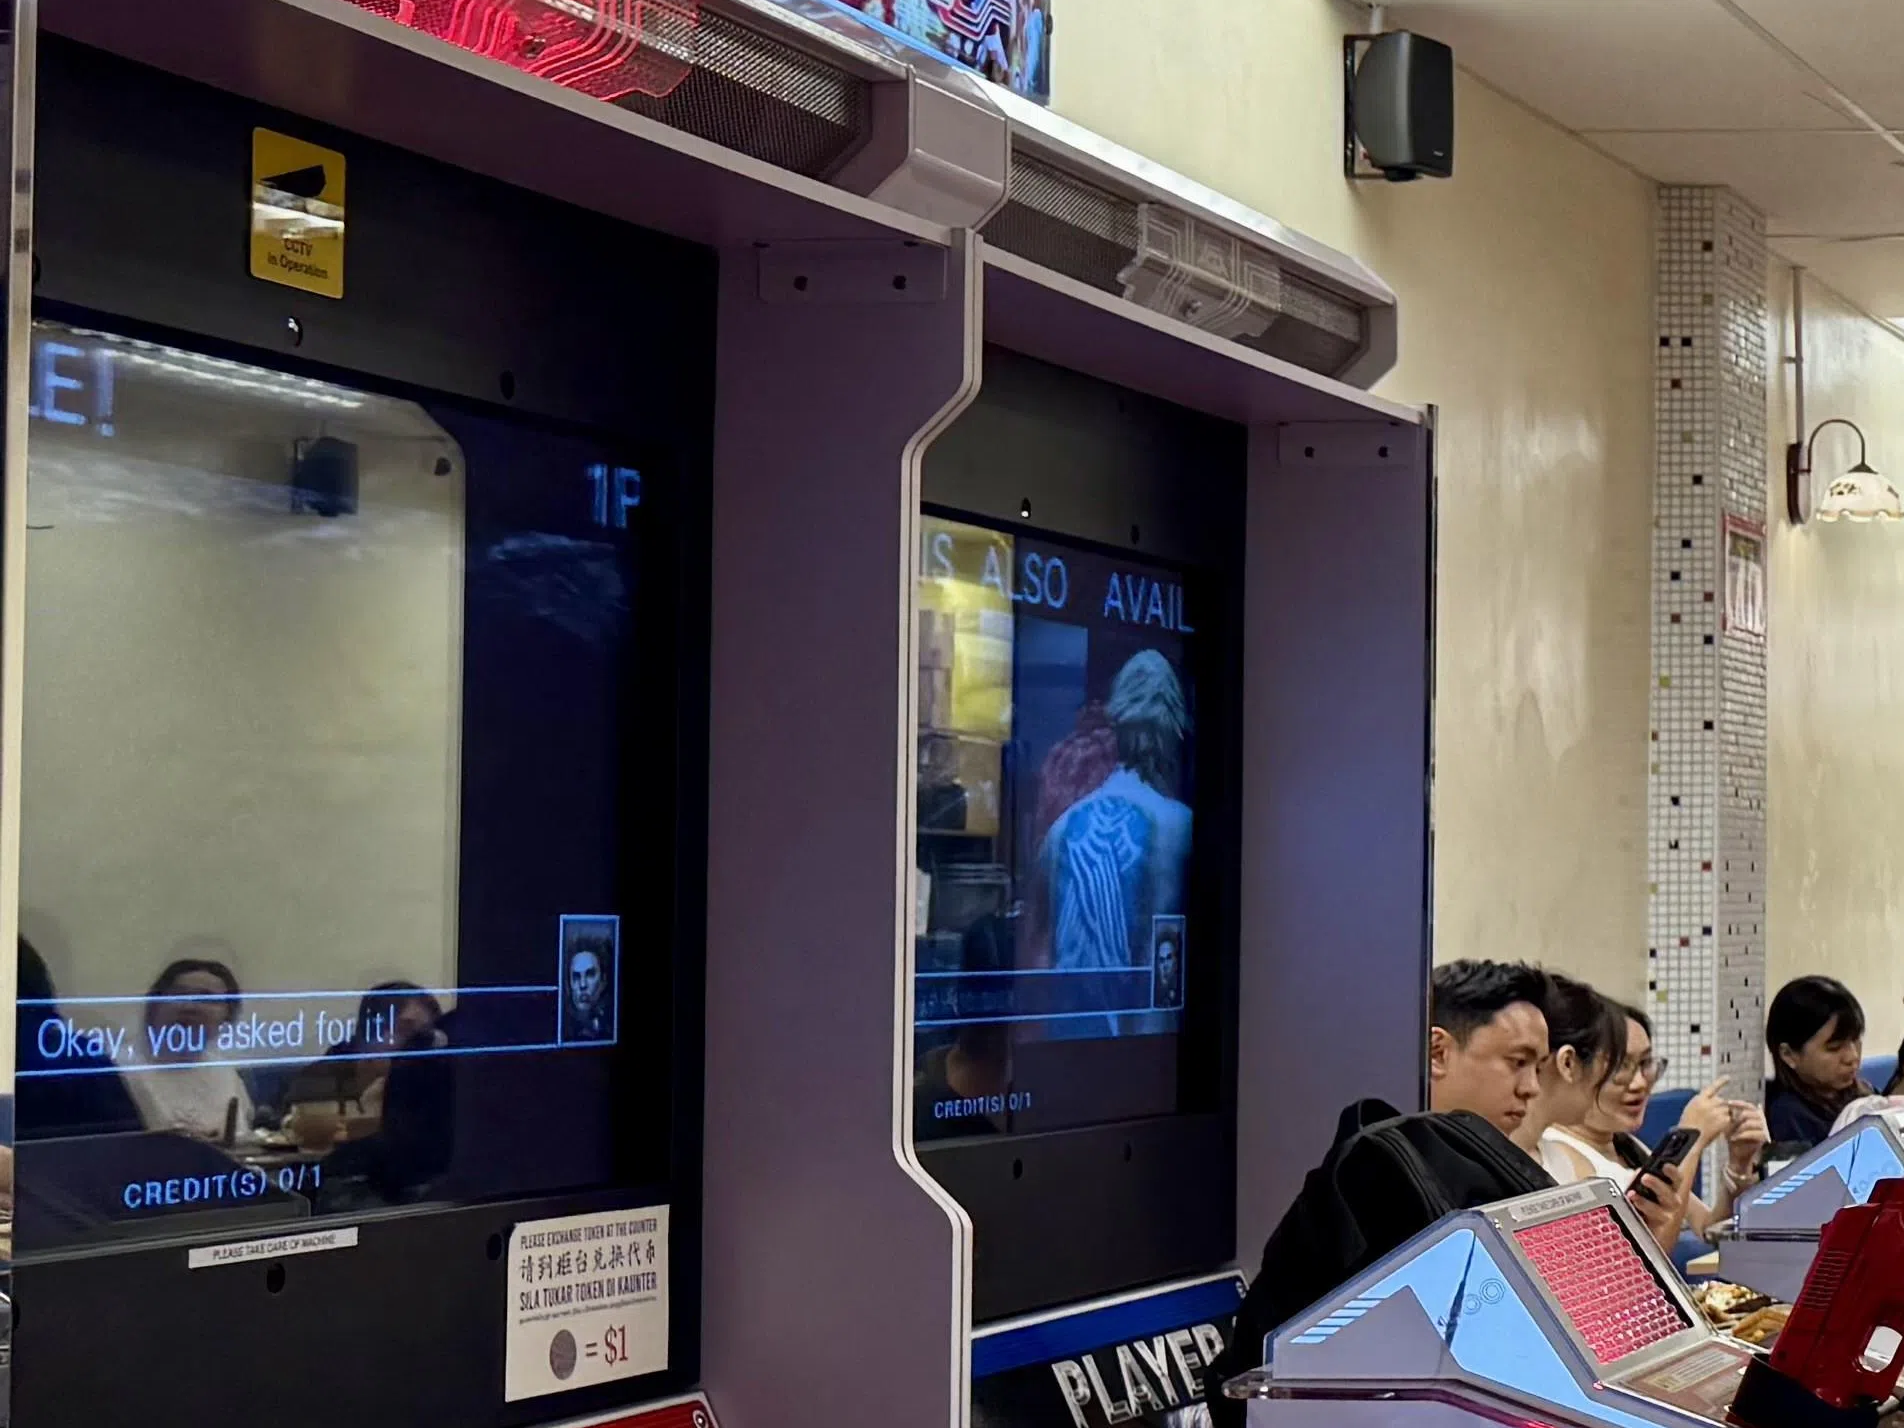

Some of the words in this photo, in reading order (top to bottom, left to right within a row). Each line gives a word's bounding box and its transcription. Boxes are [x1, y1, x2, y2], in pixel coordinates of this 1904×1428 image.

[283, 237, 313, 257] CCTV
[980, 544, 1068, 610] ALSO
[37, 1018, 134, 1060] Okay,
[148, 1021, 205, 1057] you
[216, 1009, 304, 1050] asked
[314, 1010, 357, 1046] for
[364, 1003, 396, 1045] it!
[934, 1094, 1005, 1119] CREDIT(S)
[122, 1169, 268, 1209] CREDIT(S)
[278, 1163, 322, 1193] 0/1
[520, 1232, 545, 1250] PLEASE
[547, 1227, 582, 1247] EXCHANGE
[584, 1224, 605, 1241] TOKEN
[616, 1221, 627, 1236] THE
[628, 1218, 658, 1235] COUNTER
[519, 1238, 656, 1284] 请到柜台兑换代币
[543, 1284, 573, 1308] TUKAR
[575, 1278, 605, 1303] TOKEN
[606, 1277, 615, 1298] DI
[618, 1271, 657, 1294] KAUNTER
[604, 1324, 629, 1367] $1
